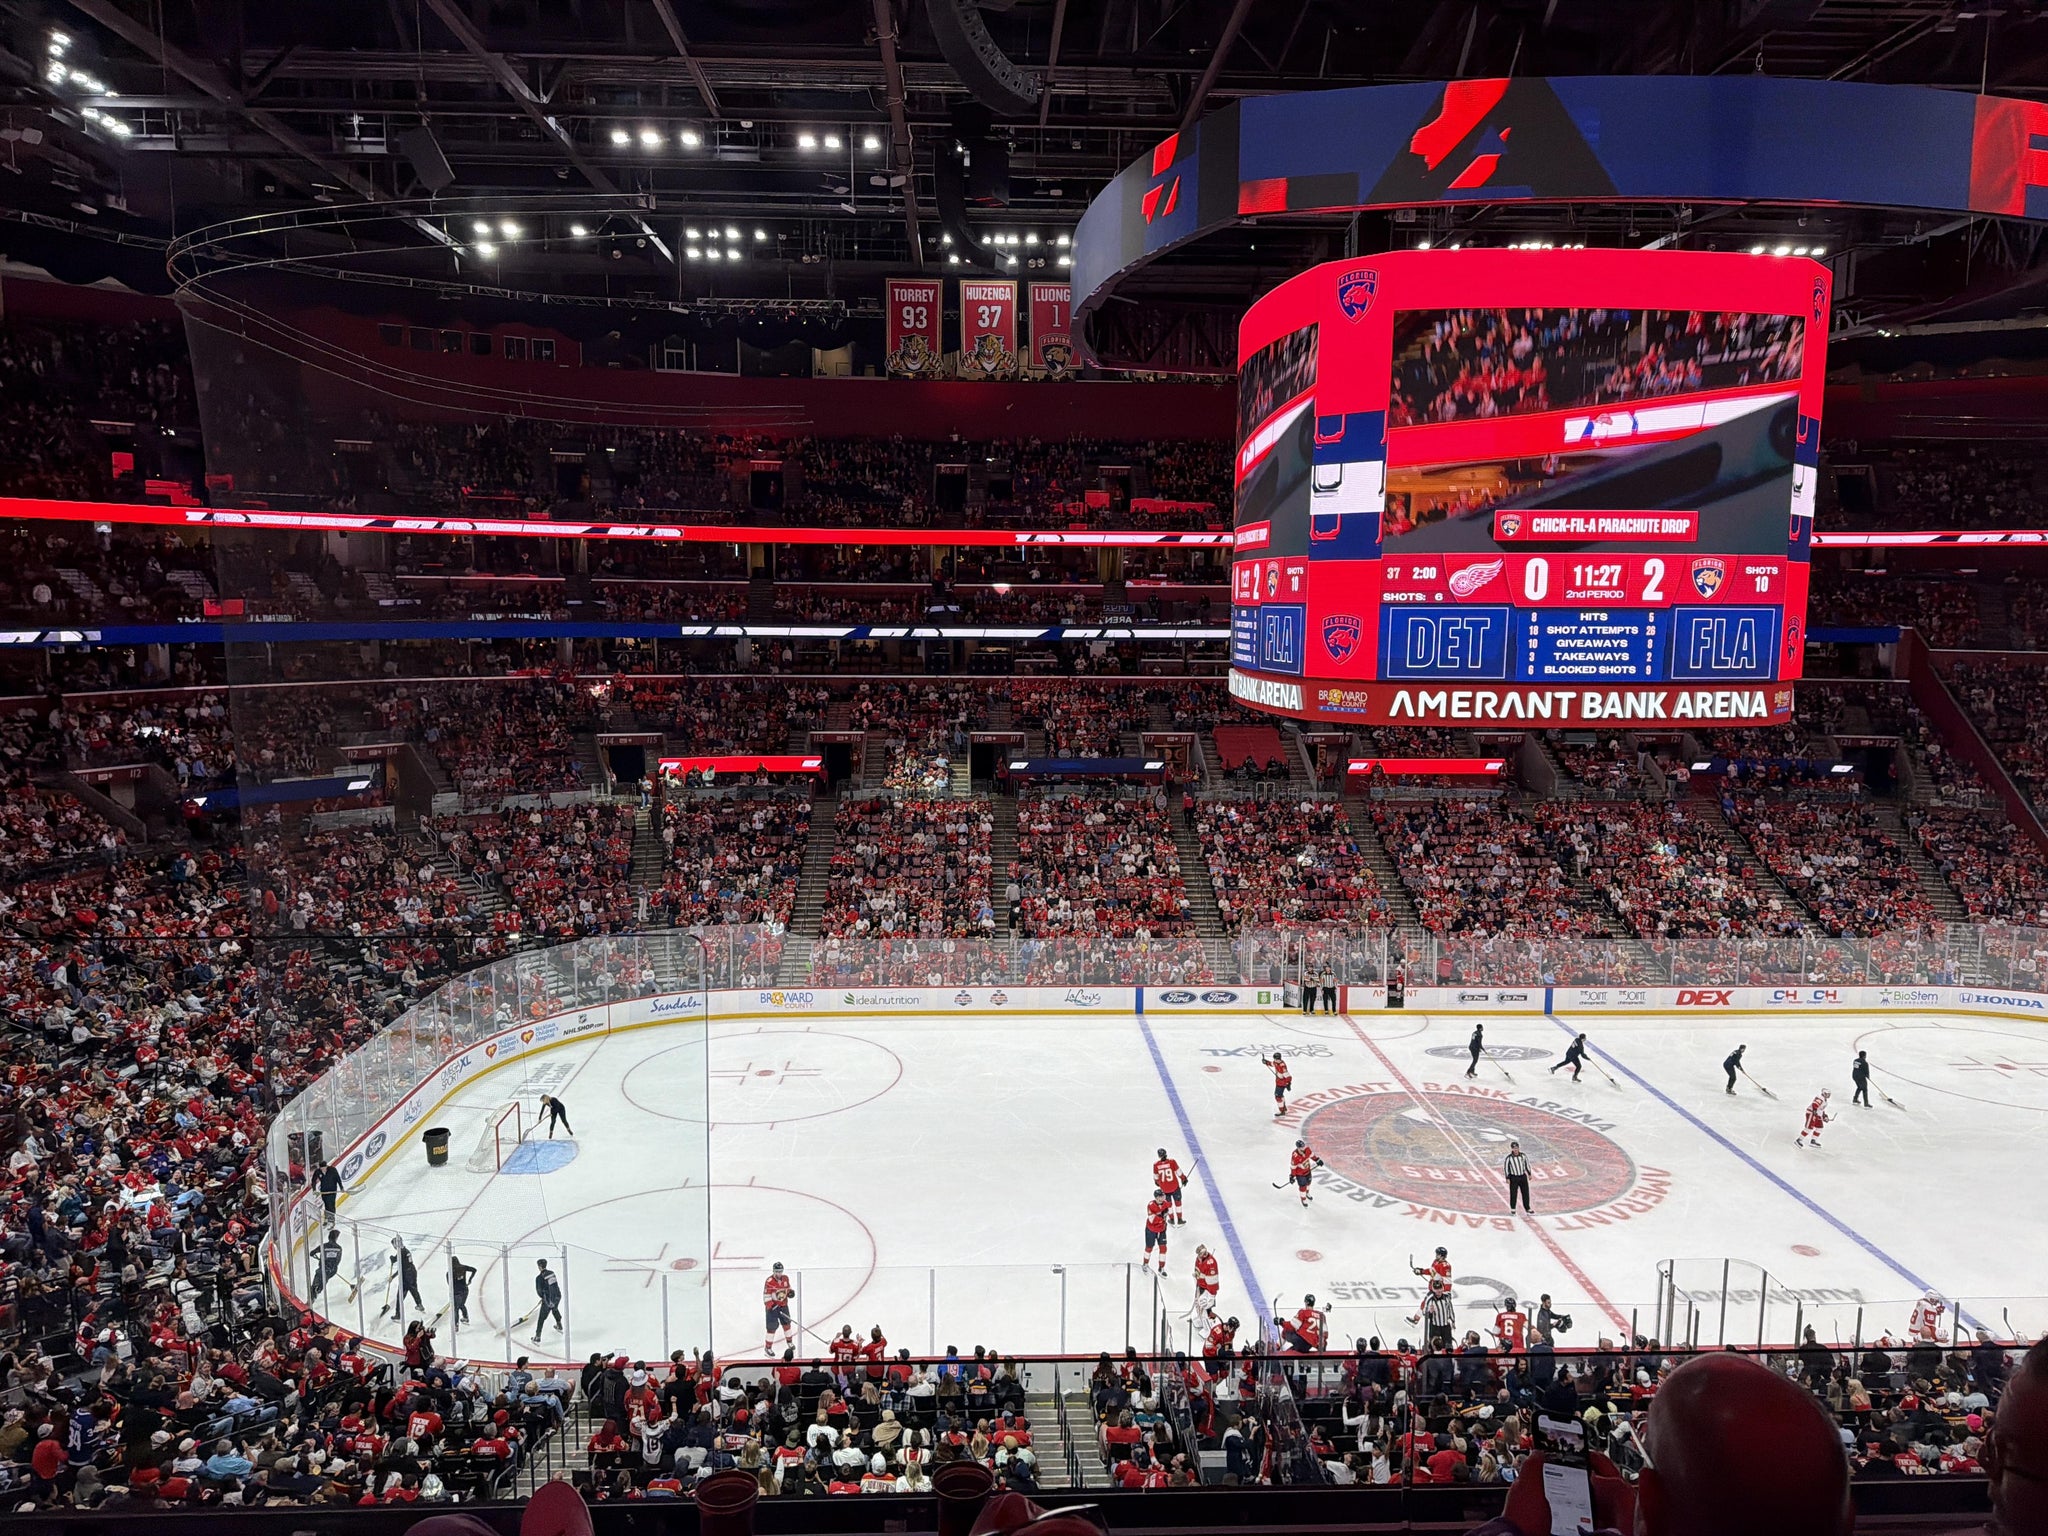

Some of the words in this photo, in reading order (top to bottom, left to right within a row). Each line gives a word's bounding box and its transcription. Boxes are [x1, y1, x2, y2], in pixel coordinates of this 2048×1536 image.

[893, 288, 935, 302] TORREY
[966, 287, 1011, 300] HUIZENGA
[1035, 288, 1071, 302] LUONG
[902, 306, 927, 329] 93
[978, 305, 1001, 328] 37
[1052, 304, 1061, 328] 1
[1532, 518, 1596, 533] CHICK-FIL-A
[1598, 518, 1660, 533] PARACHUTE
[1661, 519, 1690, 534] DROP
[1286, 566, 1304, 575] SHOTS
[1387, 567, 1400, 579] 37
[1412, 567, 1437, 579] 2:00
[1573, 564, 1621, 586] 11:27
[1745, 566, 1779, 574] SHOTS
[1253, 562, 1261, 600] 2
[1291, 576, 1299, 592] 10
[1525, 557, 1549, 601] 0
[1642, 557, 1665, 601] 2
[1755, 576, 1769, 592] 10
[1383, 593, 1426, 601] SHOTS:
[1434, 593, 1443, 601] 6
[1566, 590, 1586, 598] 2nd
[1587, 590, 1624, 598] PERIOD
[1580, 612, 1608, 621] HITS
[1648, 612, 1654, 622] 5
[1546, 626, 1576, 635] SHOT
[1579, 626, 1639, 635] ATTEMPTS
[1646, 626, 1656, 635] 26
[1265, 615, 1293, 663] FLA
[1406, 617, 1491, 669] DET
[1528, 639, 1538, 648] 10
[1556, 639, 1628, 648] GIVEAWAYS
[1690, 618, 1757, 669] FLA
[1529, 652, 1535, 662] 3
[1554, 652, 1630, 661] TAKEAWAYS
[1646, 652, 1652, 662] 2
[1544, 665, 1597, 674] BLOCKED
[1598, 665, 1636, 674] SHOTS
[1238, 674, 1260, 703] BANK
[1260, 677, 1303, 711] ARENA
[1318, 688, 1368, 703] BROWARD
[1341, 700, 1367, 708] COUNTY
[1389, 690, 1577, 719] AMERANT
[1581, 691, 1667, 719] BANK
[1670, 690, 1769, 719] ARENA
[1010, 735, 1021, 743] 117
[1143, 735, 1155, 743] 117
[760, 992, 814, 1004] BROWARD
[1166, 991, 1191, 1004] Ford
[1206, 991, 1232, 1004] Ford
[1676, 990, 1734, 1006] DEX
[1774, 990, 1798, 1000] CH
[1813, 990, 1838, 1000] CH
[1893, 991, 1939, 1001] BioStem
[1975, 994, 2045, 1009] HONDA
[650, 995, 702, 1013] Sandals
[1272, 1082, 1393, 1129] AMERANT
[1421, 1081, 1514, 1100] BANK
[1516, 1095, 1617, 1132] ARENA
[1158, 1168, 1173, 1182] 79
[1401, 1204, 1515, 1233] BANK
[1503, 1319, 1514, 1336] 6
